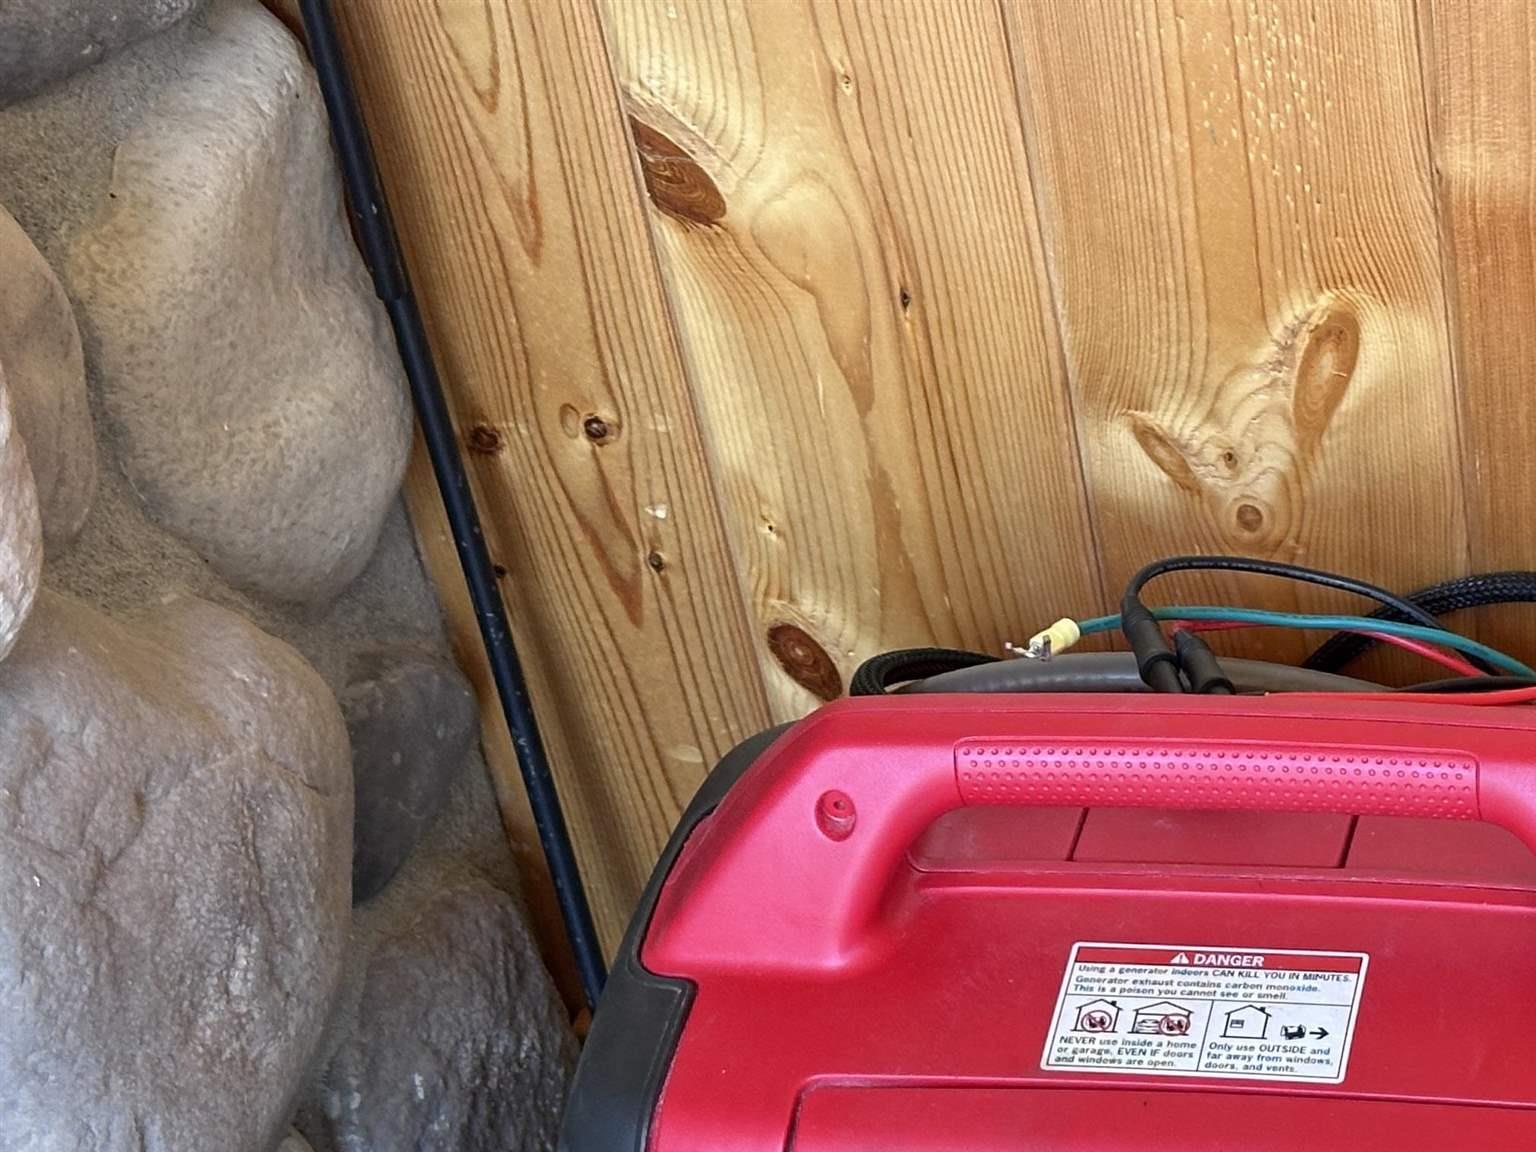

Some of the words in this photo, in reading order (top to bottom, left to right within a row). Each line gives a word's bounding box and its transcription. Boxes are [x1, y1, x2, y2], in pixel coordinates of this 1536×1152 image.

[1194, 952, 1264, 967] DANGER
[1078, 964, 1106, 975] Using
[1108, 966, 1116, 974] a
[1118, 966, 1169, 976] generator
[1171, 967, 1209, 977] indoors
[1212, 969, 1235, 978] CAN
[1238, 970, 1260, 979] KILL
[1264, 971, 1286, 980] YOU
[1288, 972, 1300, 981] IN
[1073, 984, 1094, 993] This
[1098, 984, 1106, 993] is
[1120, 985, 1154, 996] poison
[1157, 987, 1177, 997] you
[1180, 987, 1217, 997] cannot
[1220, 990, 1238, 998] see
[1242, 991, 1253, 999] or
[1075, 975, 1128, 986] Generator
[1132, 976, 1174, 987] exhaust
[1177, 978, 1222, 989] contains
[1225, 980, 1263, 990] carbon
[1265, 982, 1321, 993] monoxide.
[1059, 1035, 1096, 1045] NEVER
[1099, 1038, 1118, 1046] use
[1121, 1038, 1153, 1047] inside
[1156, 1040, 1163, 1048] a
[1166, 1040, 1198, 1049] home
[1209, 1041, 1233, 1053] Only
[1236, 1044, 1255, 1052] use
[1259, 1043, 1307, 1054] OUTSIDE
[1310, 1047, 1331, 1056] and
[1054, 1054, 1075, 1063] and
[1078, 1055, 1124, 1066] windows
[1126, 1058, 1144, 1066] are
[1057, 1046, 1069, 1054] or
[1072, 1047, 1114, 1057] garage,
[1117, 1047, 1146, 1057] EVEN
[1150, 1048, 1160, 1057] IF
[1163, 1048, 1194, 1059] doors
[1206, 1052, 1223, 1060] far
[1226, 1053, 1254, 1063] away
[1256, 1053, 1282, 1063] from
[1286, 1056, 1334, 1067] windows,
[1242, 1063, 1263, 1072] and
